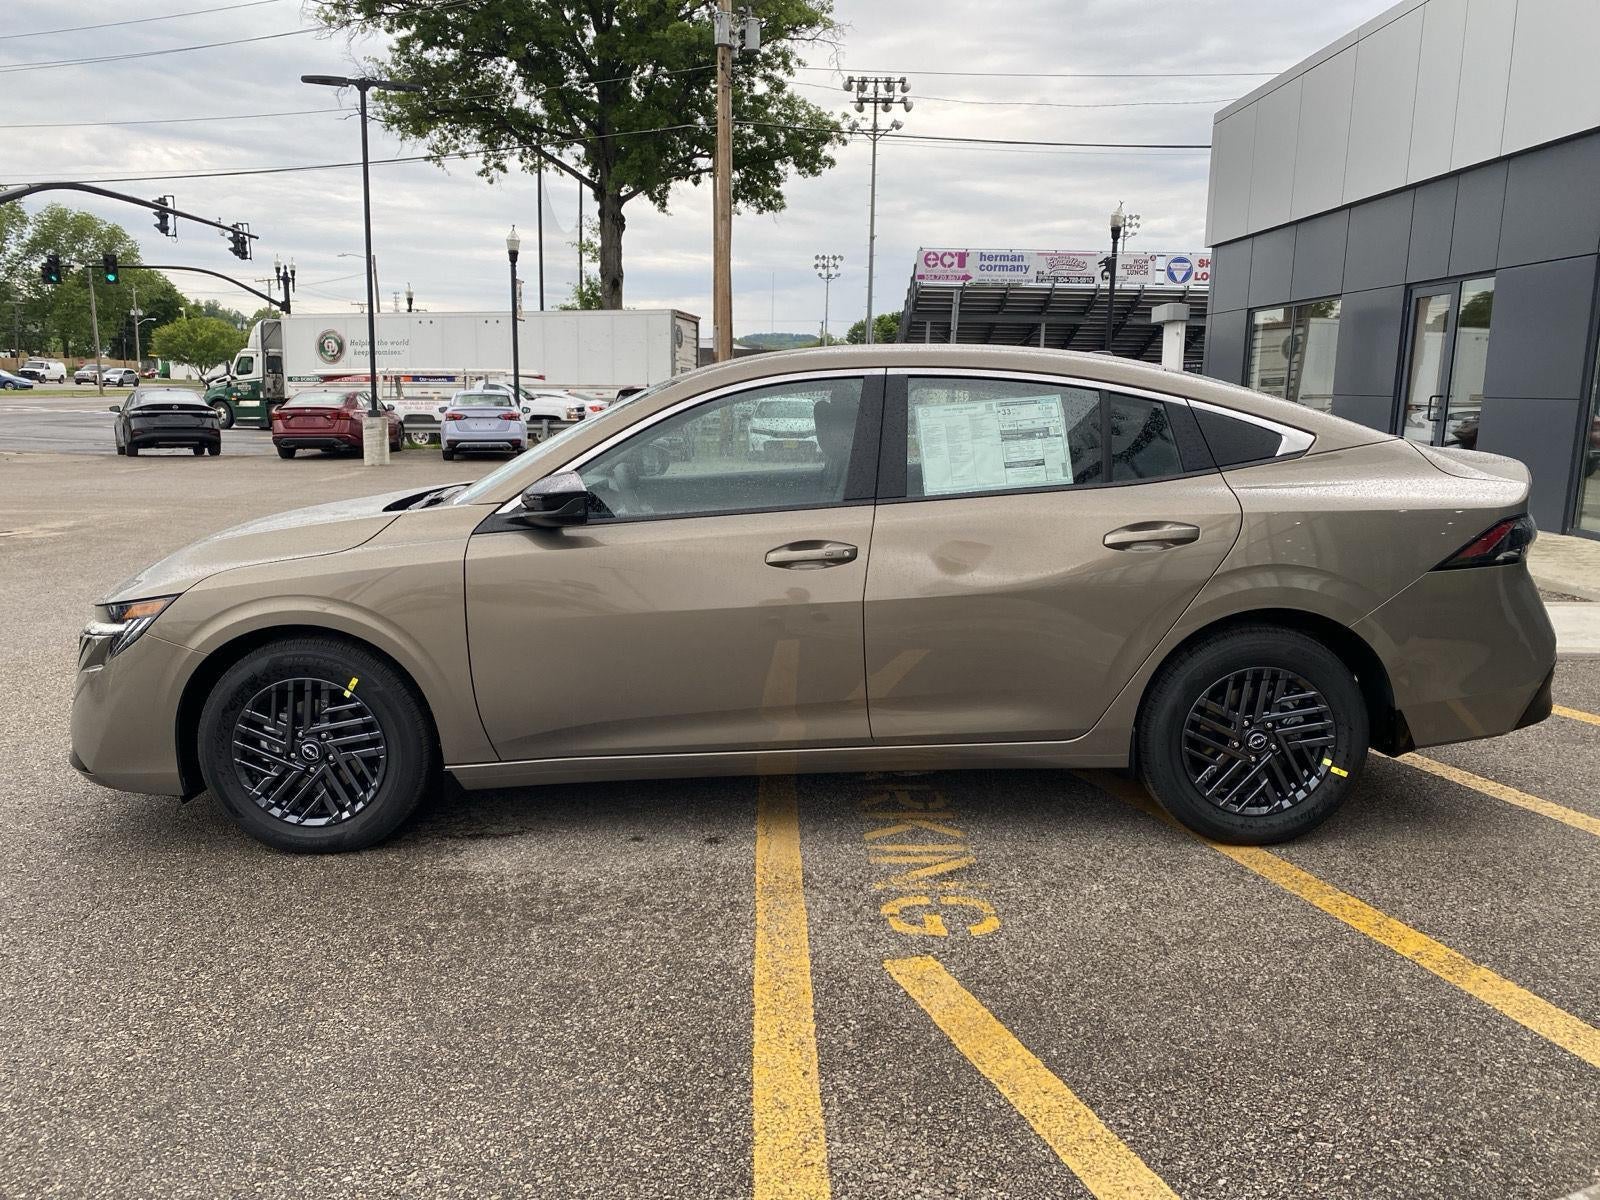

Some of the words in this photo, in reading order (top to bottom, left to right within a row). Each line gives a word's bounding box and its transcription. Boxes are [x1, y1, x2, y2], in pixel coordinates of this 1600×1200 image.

[979, 252, 1024, 262] herman
[979, 263, 1030, 275] cormany
[390, 339, 410, 347] world
[1001, 408, 1012, 416] 33
